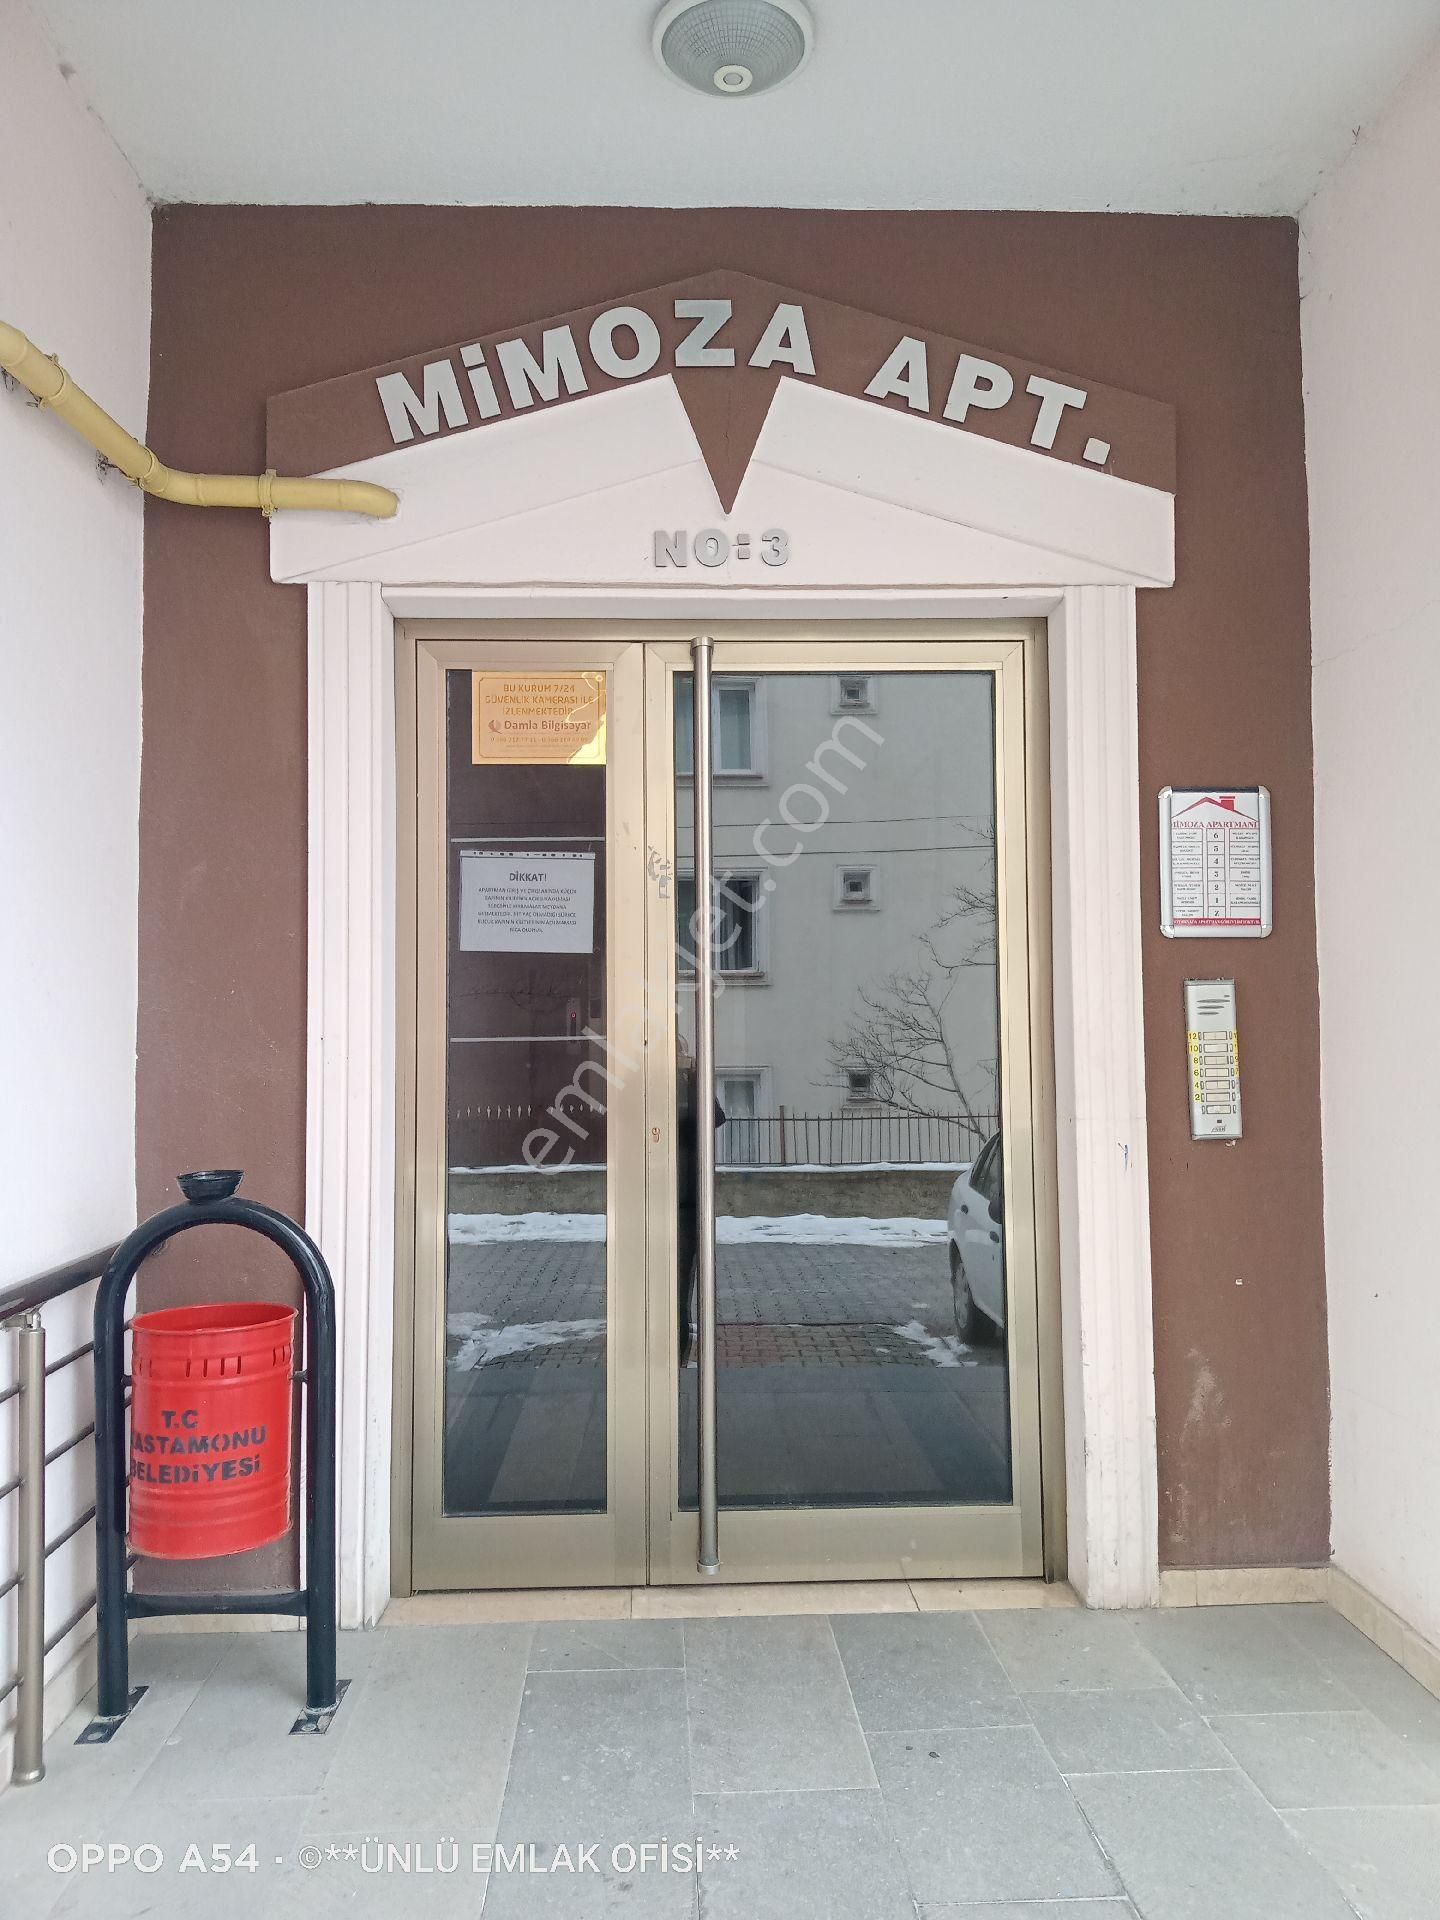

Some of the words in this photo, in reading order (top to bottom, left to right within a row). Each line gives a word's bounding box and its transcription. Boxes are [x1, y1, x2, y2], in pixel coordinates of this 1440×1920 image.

[864, 335, 1112, 465] APT.
[504, 720, 538, 730] Damla
[541, 720, 592, 732] Bilgisayar
[509, 870, 548, 882] DİKKAT!
